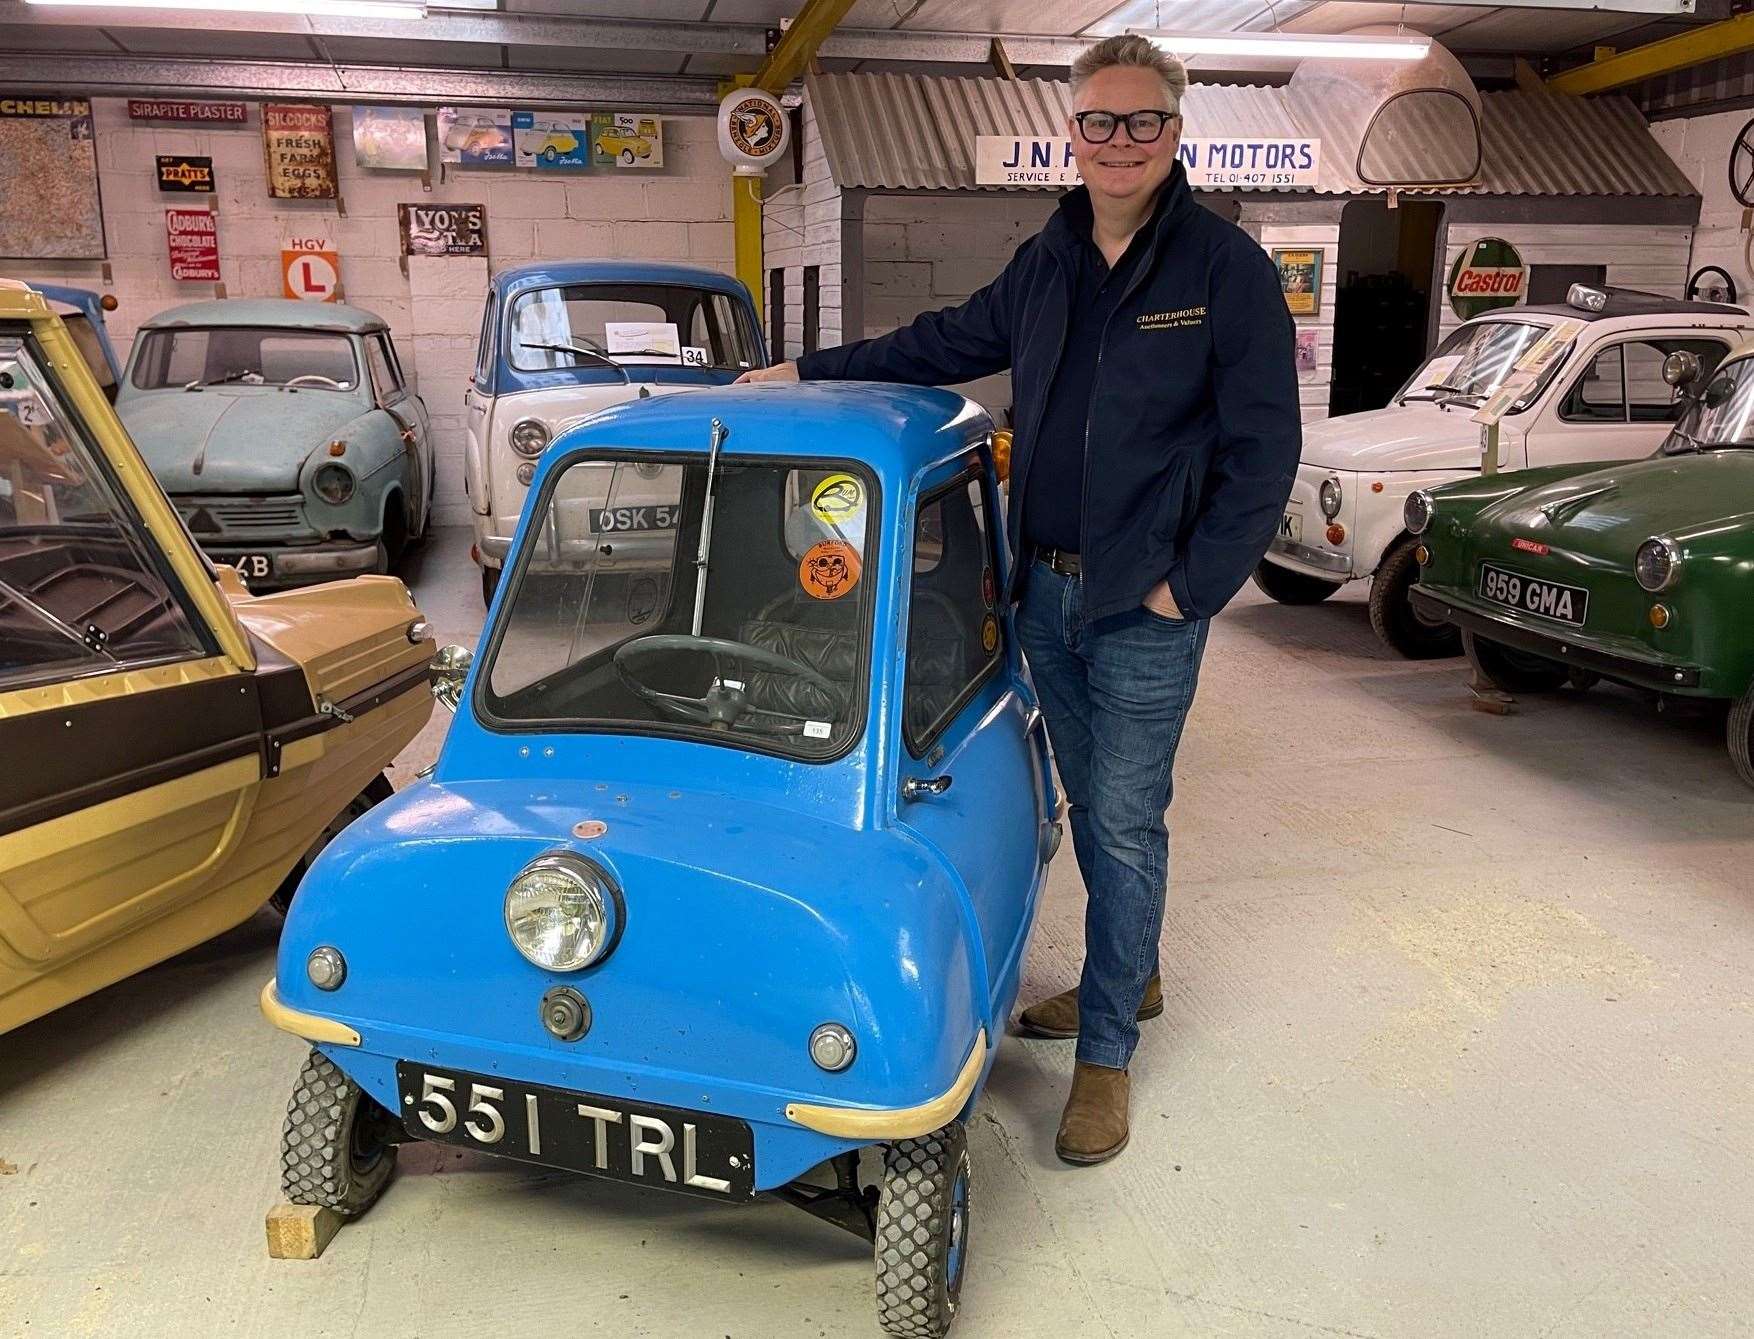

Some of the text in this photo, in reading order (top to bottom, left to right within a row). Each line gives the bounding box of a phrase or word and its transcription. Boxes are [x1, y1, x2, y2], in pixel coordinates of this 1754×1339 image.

[132, 104, 243, 120] SIRAPITE PLASTER
[267, 112, 327, 127] SILCOCKS
[620, 116, 633, 125] 500
[276, 138, 321, 149] FRESH
[1207, 143, 1313, 169] MOTORS
[165, 168, 206, 179] PRATTS
[282, 167, 321, 179] EGGS
[1007, 172, 1050, 181] SERVICE
[1205, 173, 1226, 183] TEL
[1271, 173, 1296, 184] 1551
[169, 235, 216, 247] CHOCOLATE
[292, 239, 325, 250] HGV
[302, 262, 326, 292] L
[1457, 269, 1523, 293] Castrol
[1136, 307, 1206, 323] CHARTERHOUSE
[686, 350, 704, 363] 34
[600, 508, 648, 531] OSK
[1486, 571, 1573, 620] 959 GMA
[418, 1073, 731, 1194] 551 TRL
